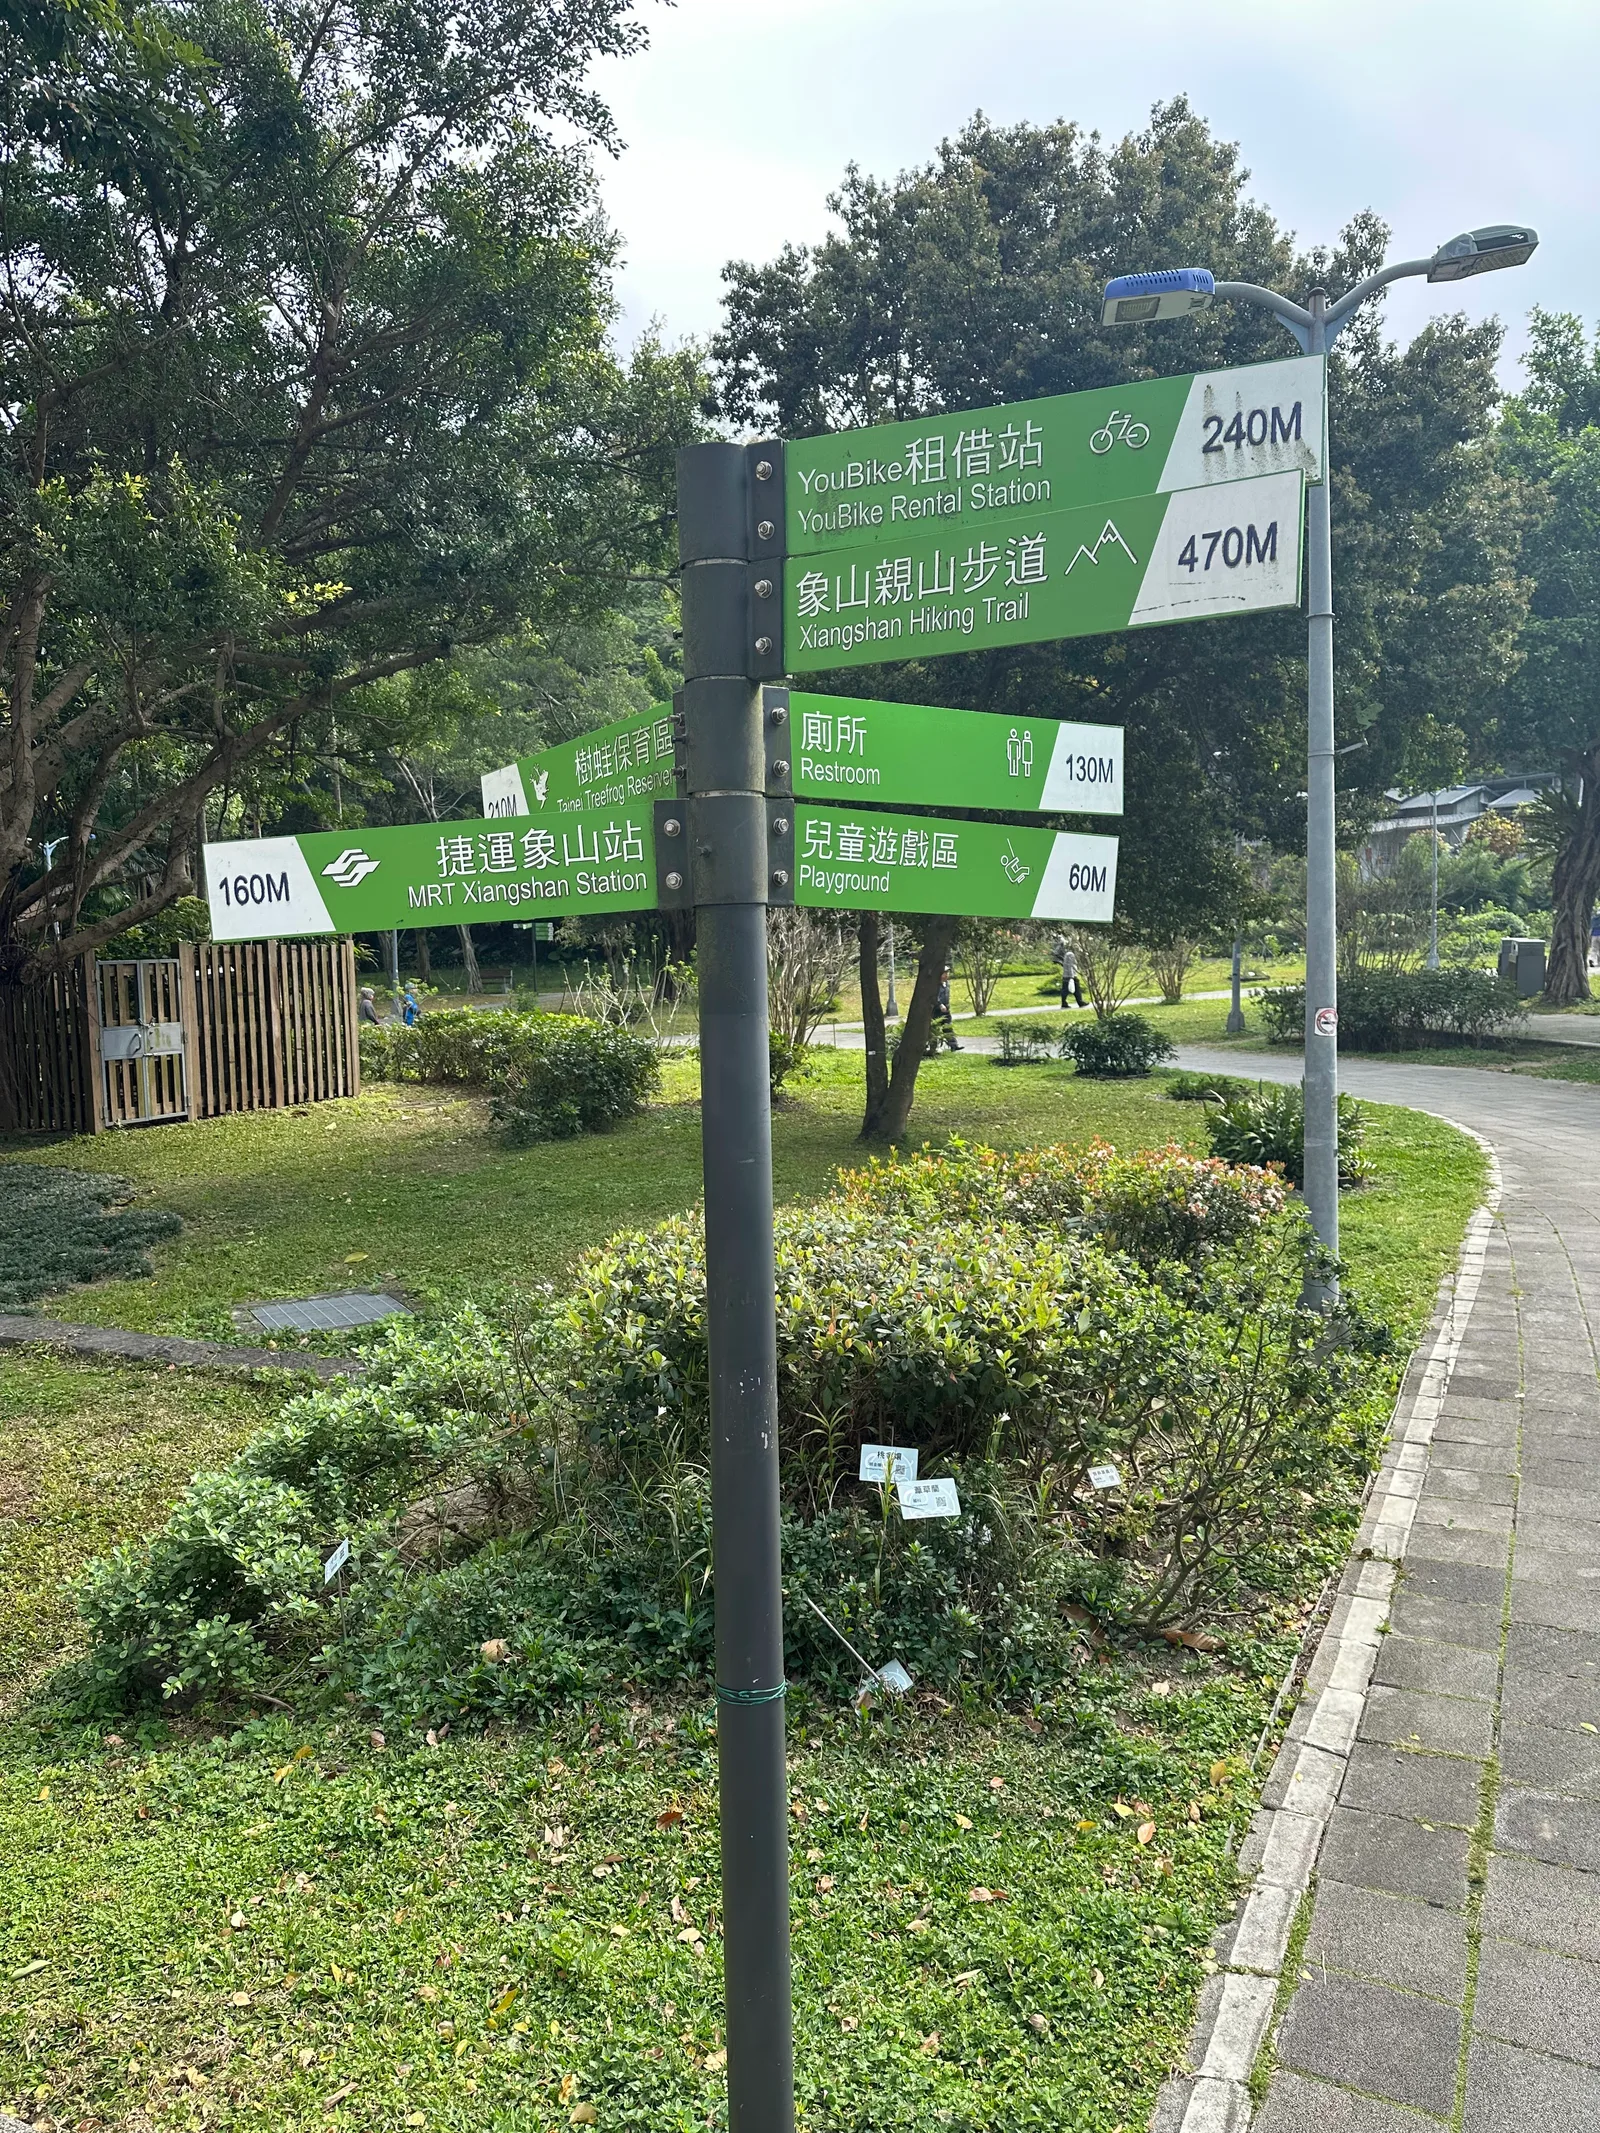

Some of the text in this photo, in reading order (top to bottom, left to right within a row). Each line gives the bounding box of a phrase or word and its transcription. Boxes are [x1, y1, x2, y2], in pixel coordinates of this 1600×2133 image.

[1202, 402, 1302, 454] 240M
[798, 420, 1043, 494] YouBike租借站
[798, 478, 1051, 535] YouBike Rental Station
[1178, 521, 1278, 574] 470M
[795, 531, 1049, 619] 象山親山步道
[799, 593, 1029, 652] Xiangshan Hiking Trail
[575, 717, 674, 787] 樹蛙保育區
[801, 711, 867, 757] 廁所
[801, 757, 880, 785] Restroom
[1065, 754, 1114, 784] 130M
[585, 783, 625, 809] Treefrog
[436, 819, 644, 879] 捷運象山站
[801, 818, 959, 870] 兒童遊戲區
[218, 871, 290, 907] 160M
[408, 868, 647, 909] MRT Xiangshan Station
[800, 865, 890, 895] Playground
[1069, 864, 1106, 893] 60M
